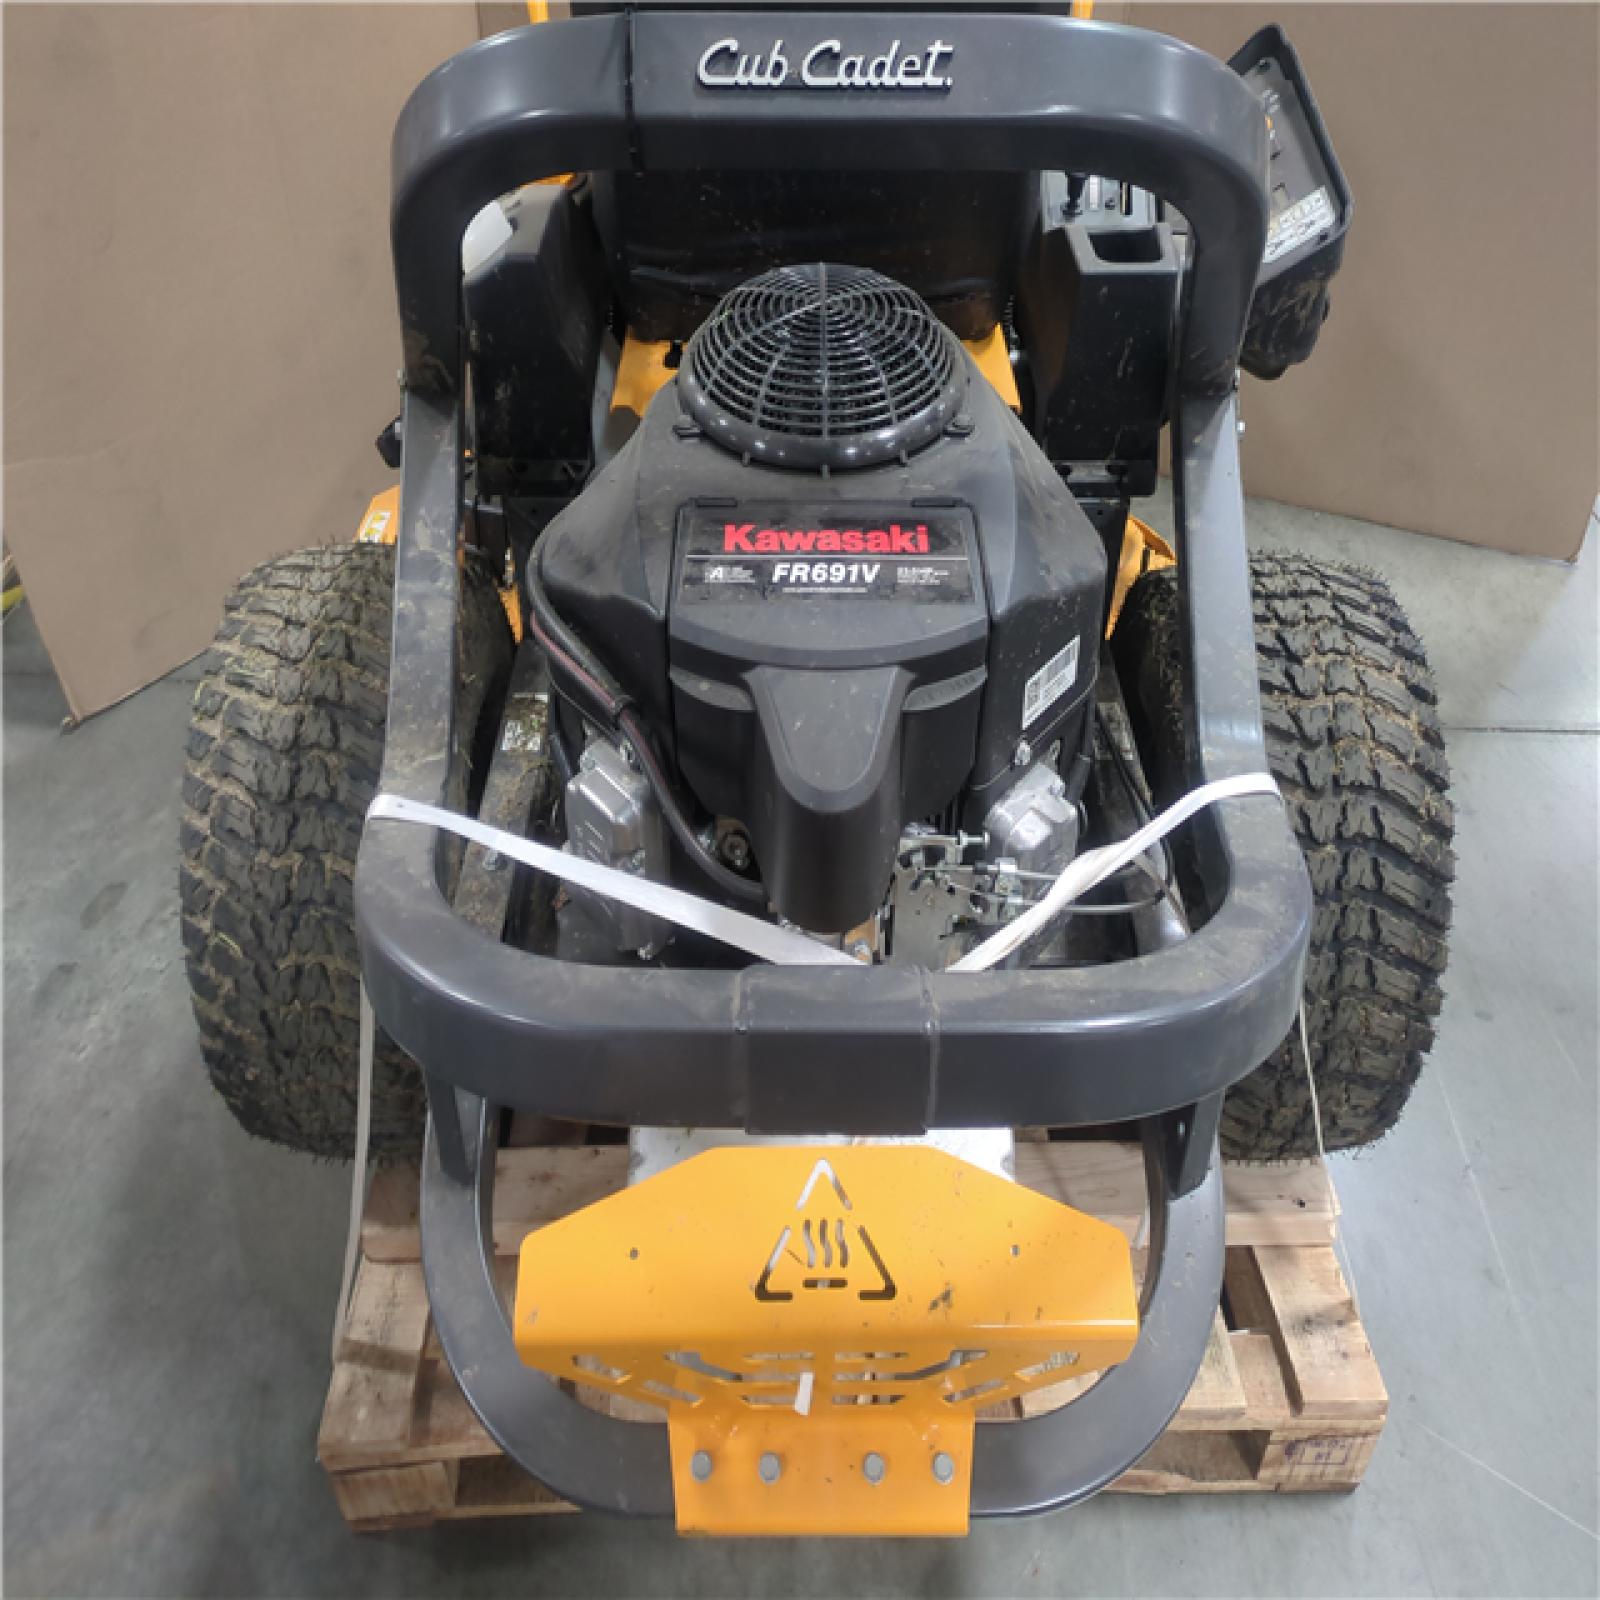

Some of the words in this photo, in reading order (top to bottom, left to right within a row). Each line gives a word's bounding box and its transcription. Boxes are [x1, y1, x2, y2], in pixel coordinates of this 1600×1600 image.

[698, 39, 789, 86] Cub
[724, 523, 930, 553] Kawasaki
[772, 562, 881, 583] FR691V
